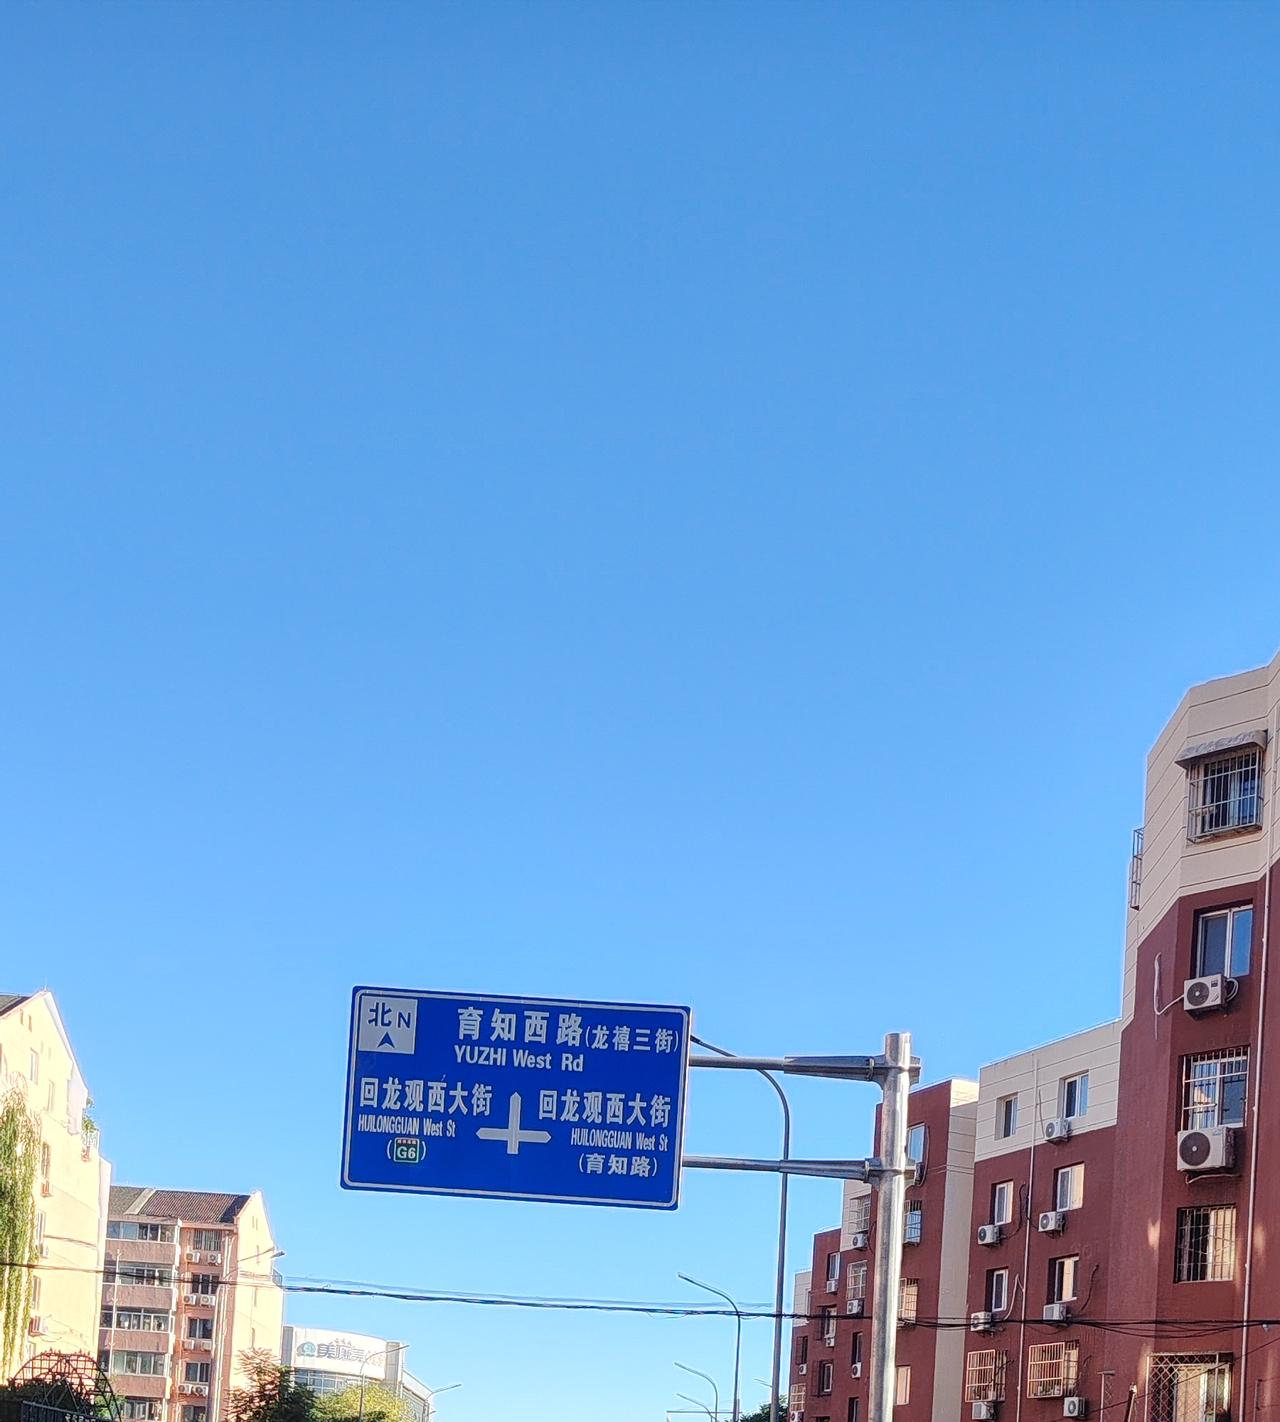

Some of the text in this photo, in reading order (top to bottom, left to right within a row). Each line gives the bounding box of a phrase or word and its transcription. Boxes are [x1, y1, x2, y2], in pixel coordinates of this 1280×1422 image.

[367, 1001, 412, 1030] 北 N
[454, 1045, 584, 1072] YUZHI West Rd
[359, 1076, 493, 1117] 回龙观西大街
[538, 1088, 671, 1128] 回龙观西大街
[358, 1113, 456, 1138] HUILONGGUAN West St
[570, 1127, 669, 1152] HUILONGGUAN West St
